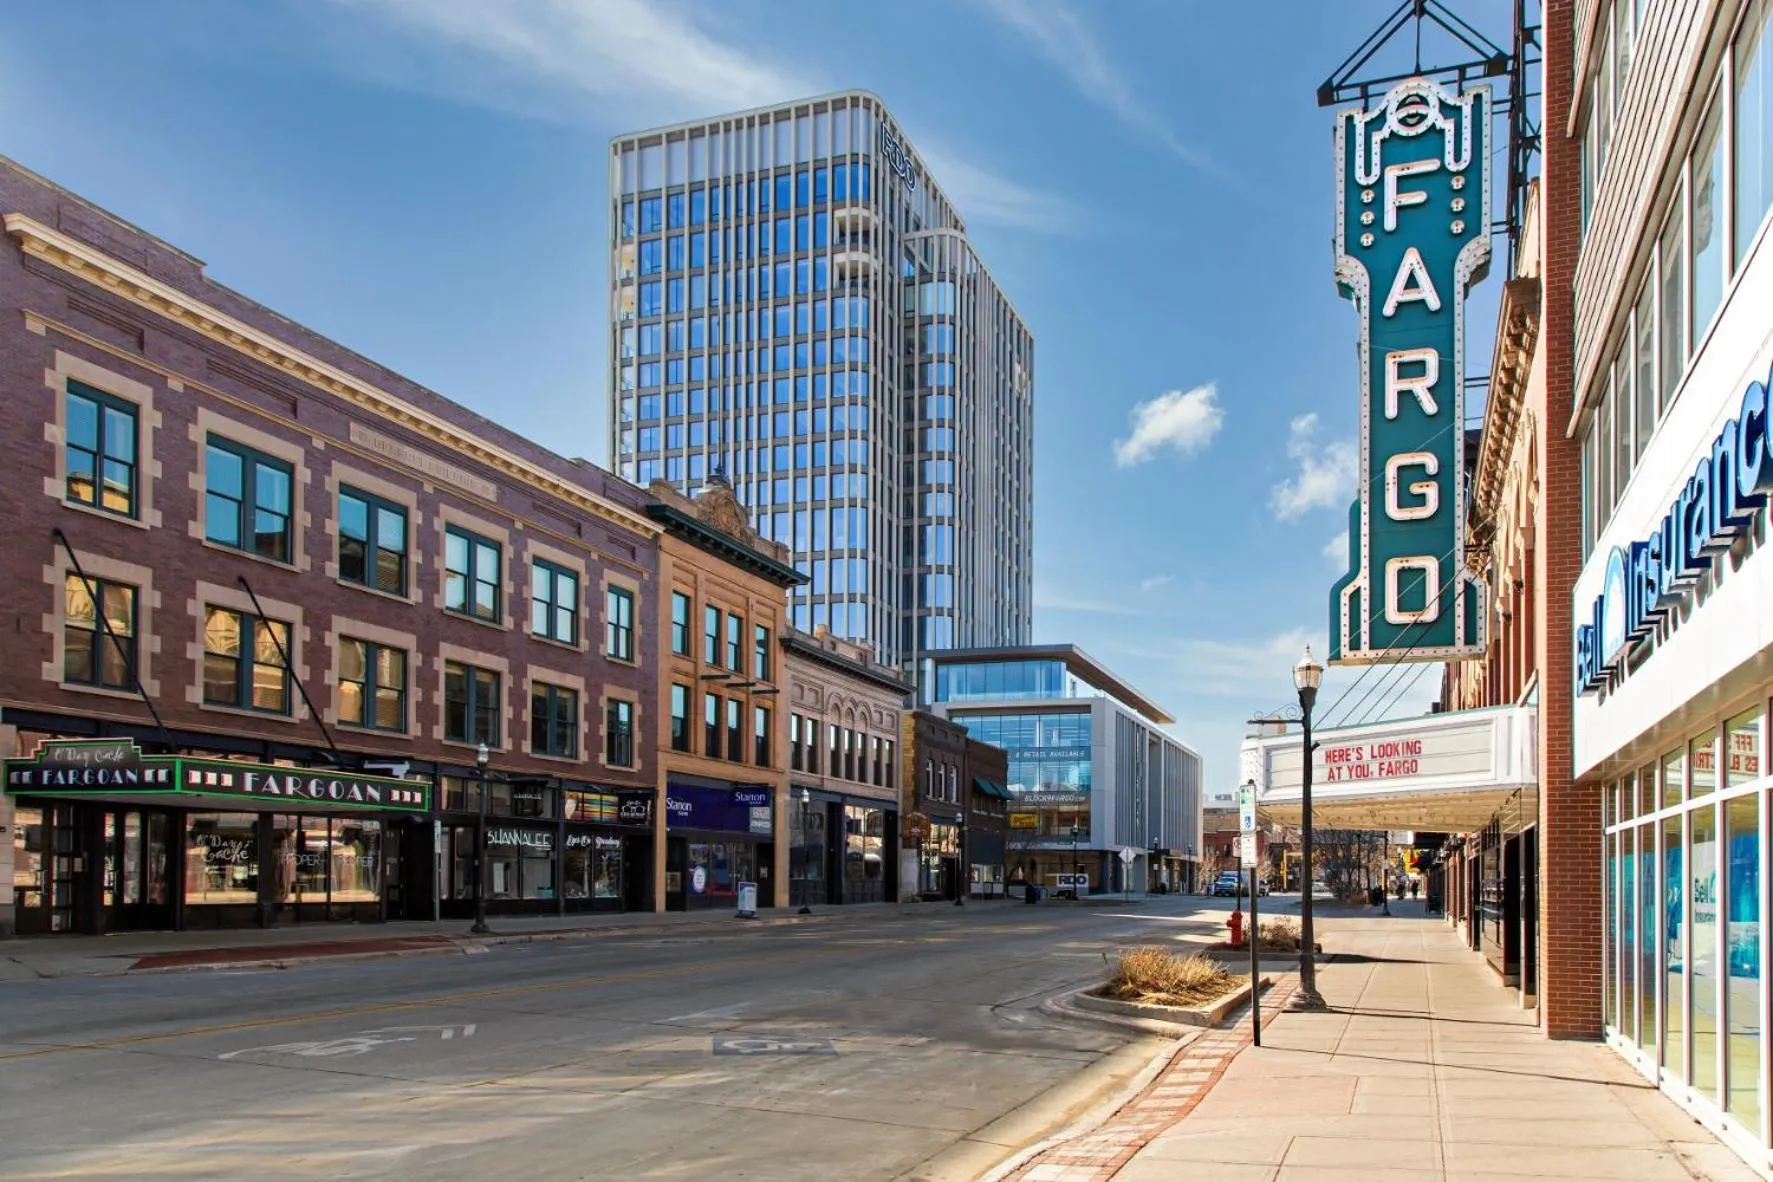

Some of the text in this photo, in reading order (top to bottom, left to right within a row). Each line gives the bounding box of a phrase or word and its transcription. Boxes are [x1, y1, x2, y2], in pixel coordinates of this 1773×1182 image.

[881, 123, 917, 192] RDO
[1382, 157, 1442, 626] FARGO
[1325, 741, 1422, 763] HERE'S LOOKING
[42, 768, 138, 786] FARGOAN
[1328, 767, 1343, 780] AT
[1379, 760, 1418, 776] FARGO
[242, 772, 381, 803] FARGOAN
